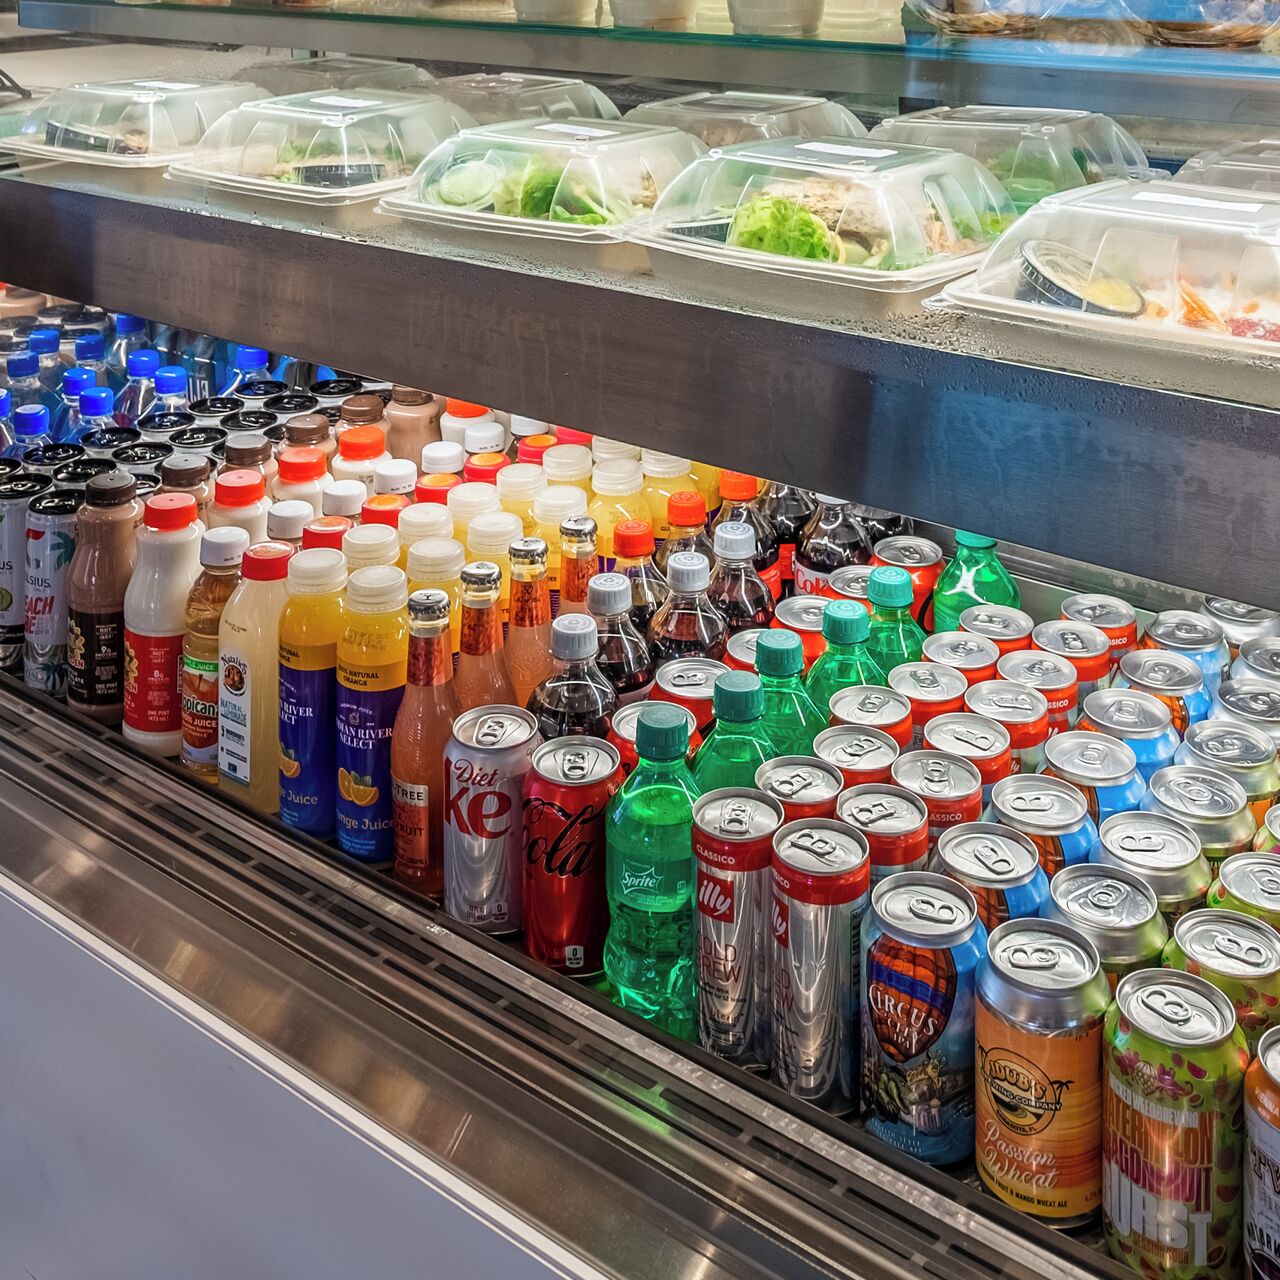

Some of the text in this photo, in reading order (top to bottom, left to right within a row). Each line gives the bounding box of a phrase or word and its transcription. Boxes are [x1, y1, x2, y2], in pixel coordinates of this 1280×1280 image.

[197, 663, 214, 671] JUICE
[348, 670, 380, 680] NATURAL
[343, 675, 368, 687] ORANGE
[284, 703, 314, 718] RIVER
[193, 718, 218, 728] JUICE
[358, 724, 393, 739] RIVER
[340, 731, 376, 750] SELECT
[454, 759, 498, 786] Diet
[287, 790, 319, 805] Juice
[696, 844, 736, 866] CLASSICO
[622, 871, 657, 888] Sprite
[699, 879, 732, 917] illy
[698, 936, 737, 963] OLD
[698, 954, 742, 984] REW
[869, 984, 938, 1037] CIRCUS
[893, 1033, 911, 1049] IPA
[1015, 1093, 1063, 1112] COMPANY
[1255, 1087, 1280, 1116] VIENNA
[984, 1119, 1056, 1166] Passion
[984, 1147, 1059, 1190] Wheat
[1015, 1191, 1035, 1204] MANGO
[1036, 1198, 1056, 1208] WHEAT
[1057, 1199, 1068, 1208] ALE
